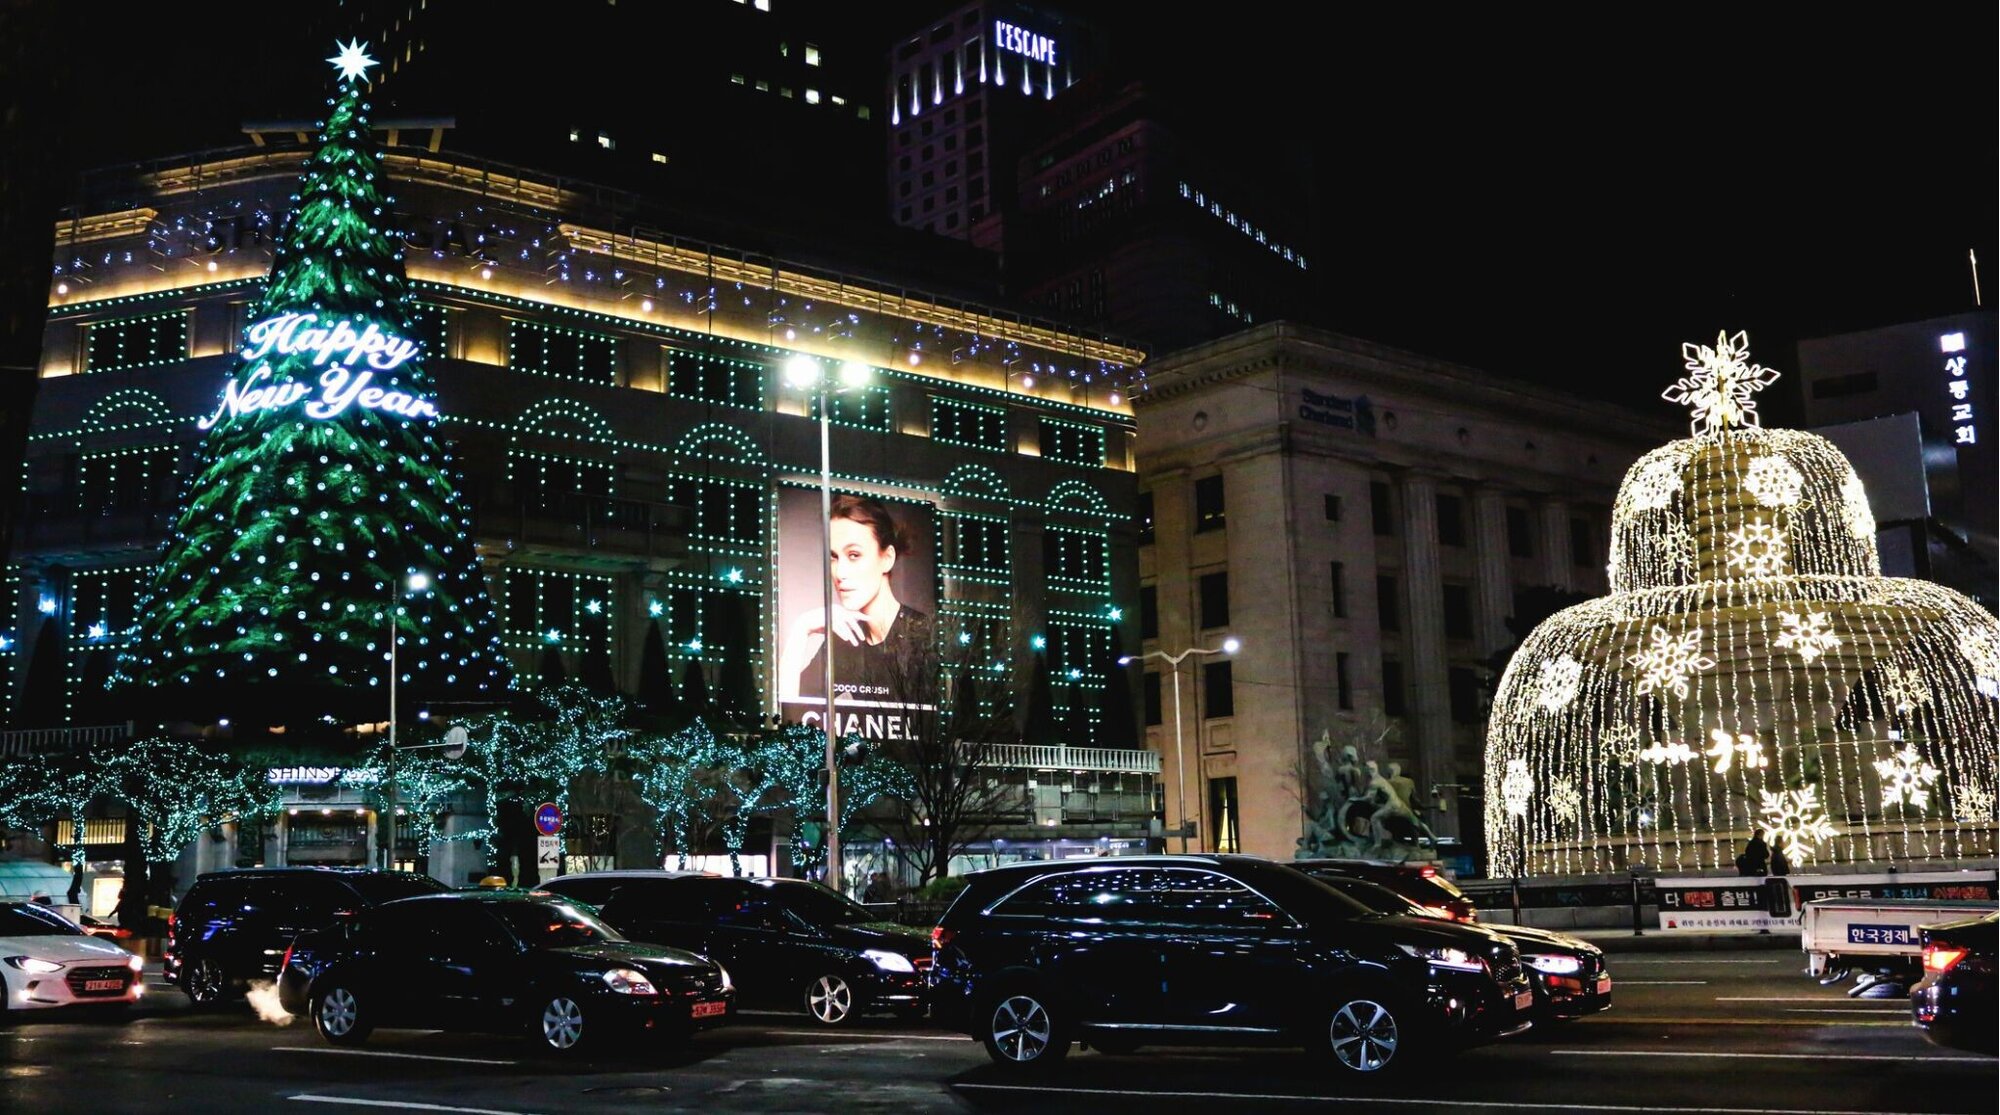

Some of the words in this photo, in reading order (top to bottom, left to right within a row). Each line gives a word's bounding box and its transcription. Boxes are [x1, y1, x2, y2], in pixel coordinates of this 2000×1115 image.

[996, 20, 1056, 66] L'ESCAPE
[242, 313, 419, 370] Happy
[198, 365, 313, 429] New
[306, 366, 438, 419] Year
[833, 683, 858, 693] COCO
[859, 685, 890, 695] CRUSH
[1664, 891, 1681, 907] 다
[1720, 890, 1759, 907] 출발!
[1850, 928, 1909, 943] 한국경제
